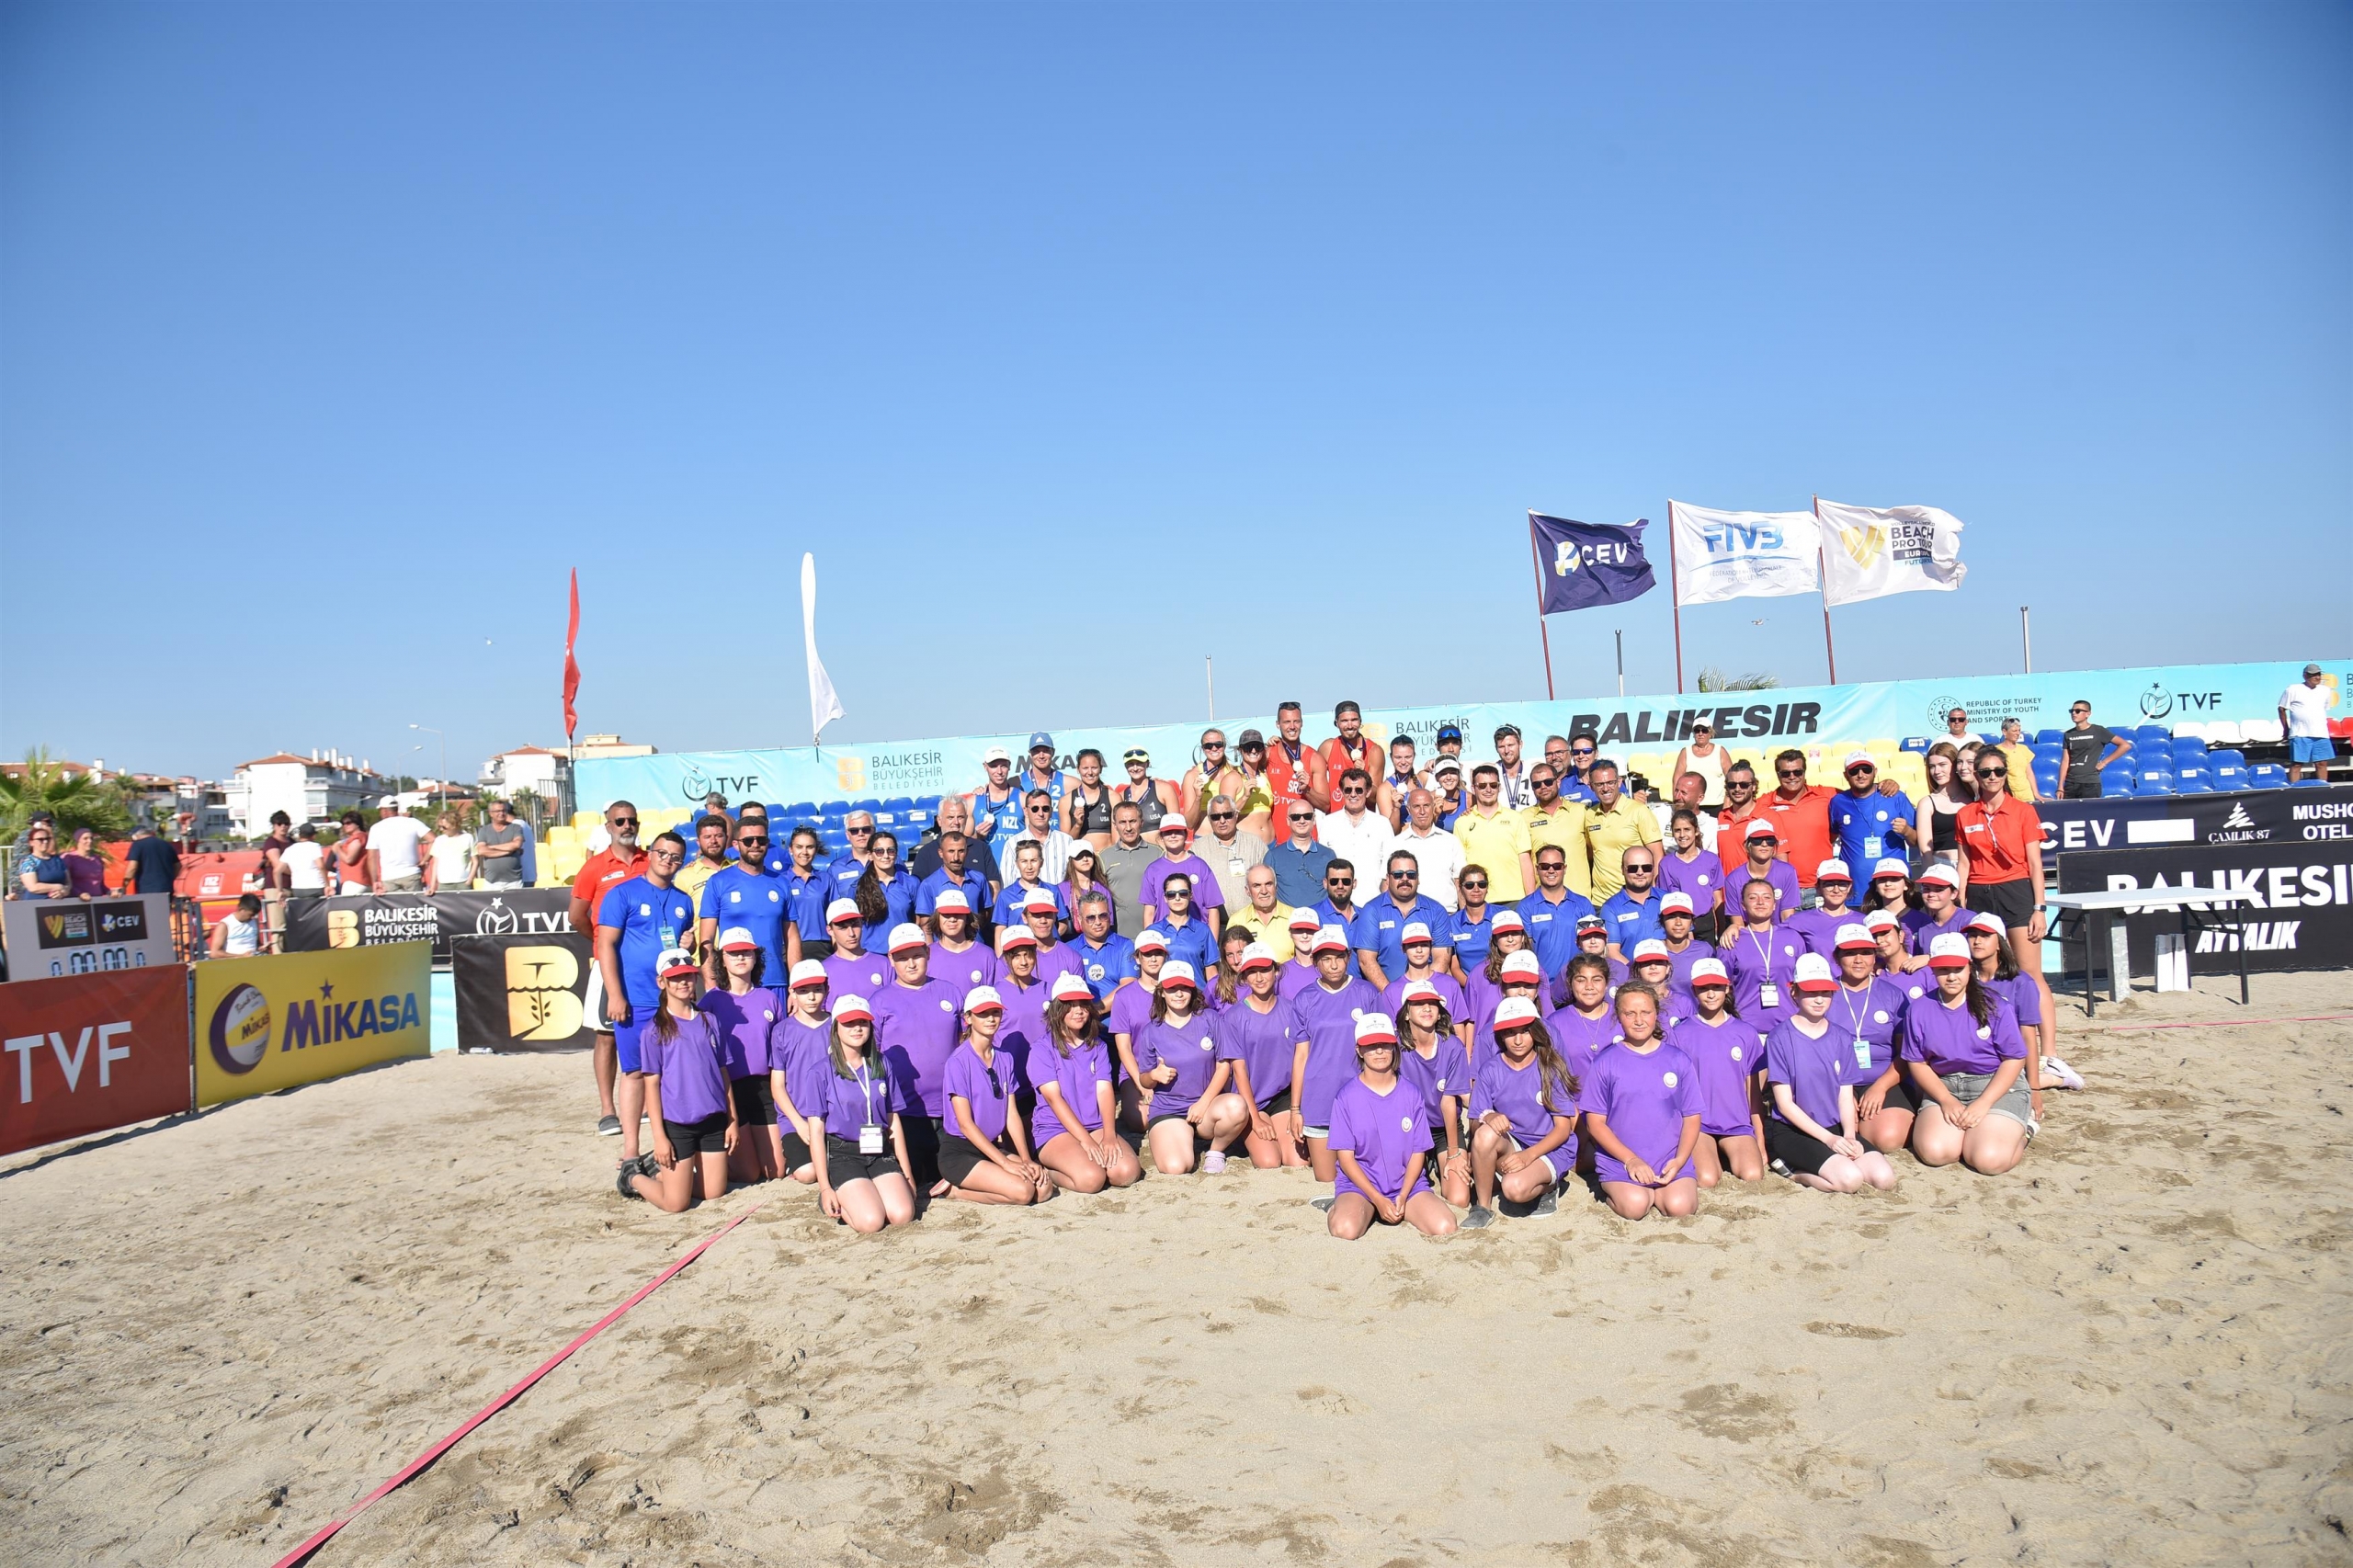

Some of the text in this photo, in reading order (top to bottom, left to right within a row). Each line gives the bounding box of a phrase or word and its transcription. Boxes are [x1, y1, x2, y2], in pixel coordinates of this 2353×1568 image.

[1703, 521, 1784, 553] FIVB
[1891, 526, 1935, 540] BEACH
[1893, 539, 1933, 550] PRO TOUR
[1581, 543, 1628, 566] CEV
[1966, 698, 2042, 708] REPUBLIC OF TURKEY
[2177, 692, 2222, 711] TVF
[1966, 707, 2001, 716] MINISTRY
[1984, 715, 2010, 723] SPORT
[1567, 701, 1822, 745] BALIKESIR
[872, 751, 942, 768] BALIKESİR
[872, 766, 944, 781] BÜYÜKŞEHİR
[716, 776, 759, 794] TVF
[873, 779, 945, 790] BELEDİYESİ
[1051, 784, 1062, 798] 2
[1006, 801, 1017, 813] 1
[1100, 802, 1107, 813] 2
[1149, 801, 1156, 812] 1
[1002, 815, 1019, 830] NZL
[1149, 812, 1162, 821] USA
[2039, 819, 2116, 850] CEV
[2208, 829, 2271, 845] ÇAMLIK 87
[2302, 824, 2353, 840] OTEL
[2106, 864, 2353, 915] BALIKESI
[117, 915, 140, 927] CEV
[364, 904, 438, 924] BALIKESİR
[364, 923, 439, 937] BÜYÜKŞEHİR
[280, 992, 421, 1053] MIKASA
[4, 1019, 133, 1105] TVF
